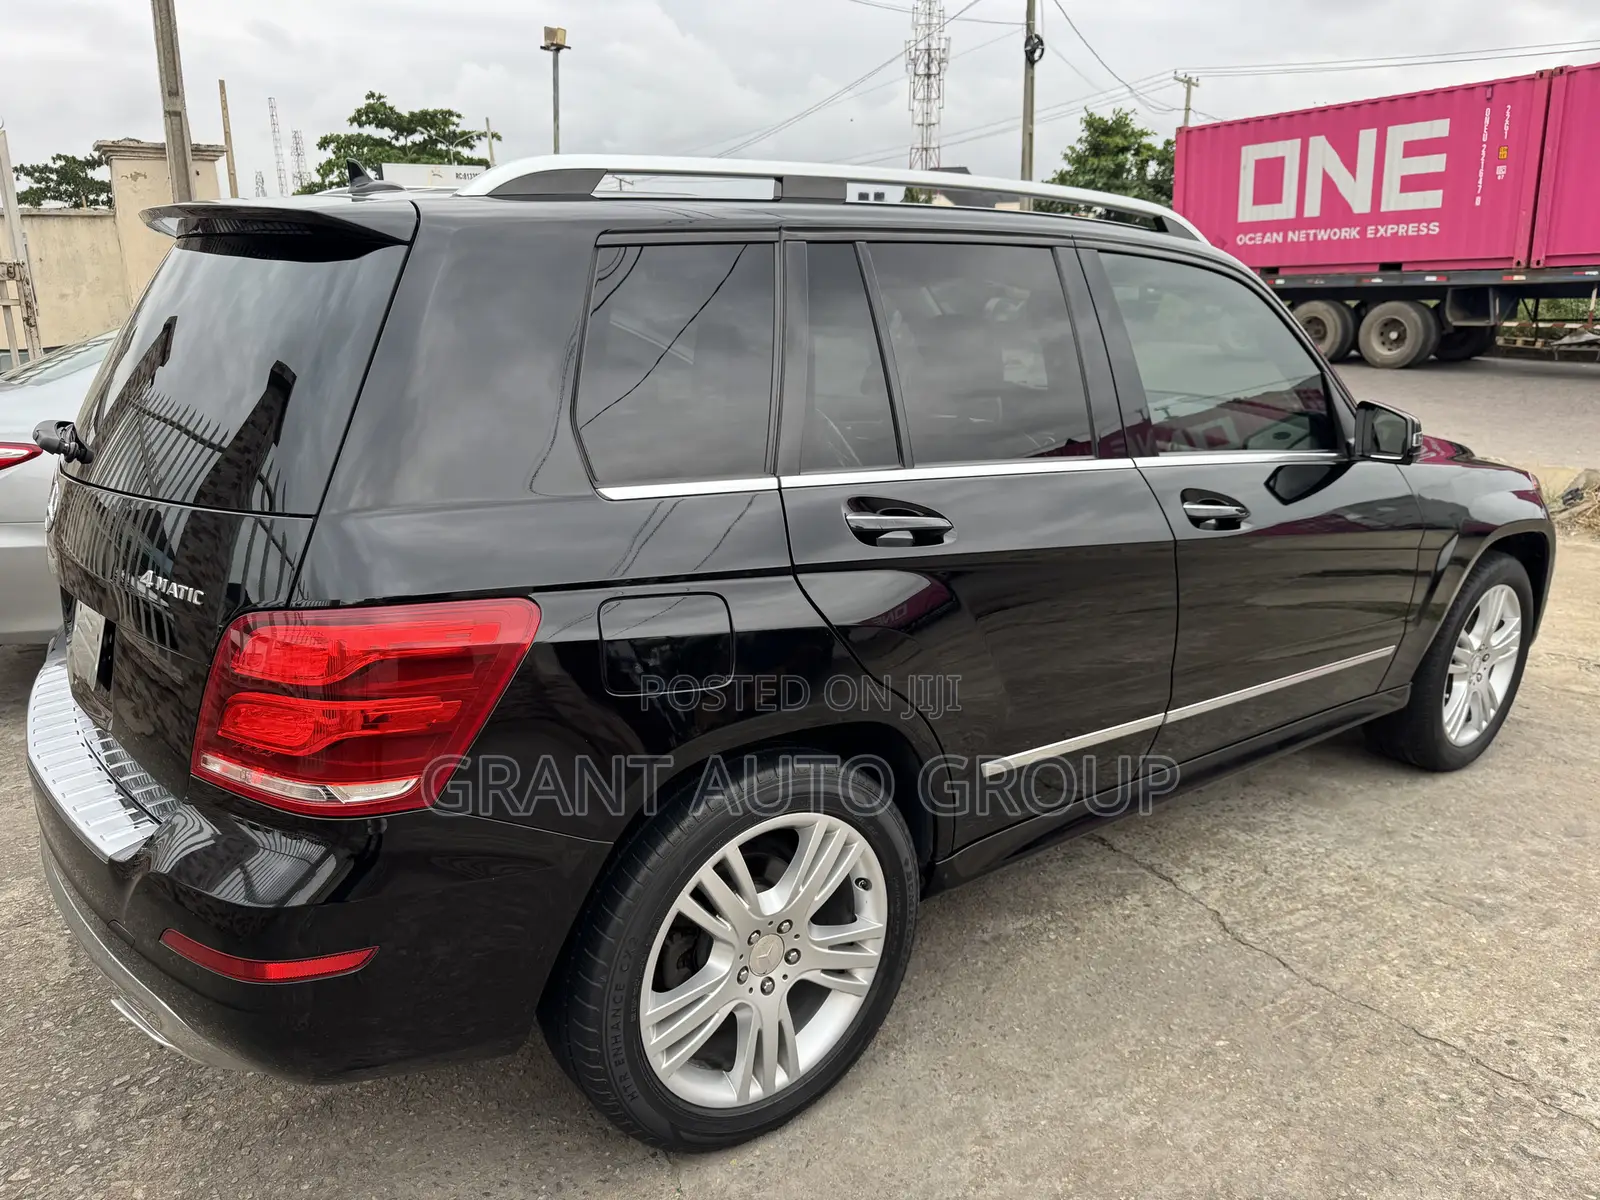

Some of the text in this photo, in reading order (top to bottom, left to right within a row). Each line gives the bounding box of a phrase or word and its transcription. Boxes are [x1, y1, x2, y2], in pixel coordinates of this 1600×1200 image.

[1482, 107, 1491, 142] ONEU
[1237, 118, 1450, 223] ONE
[1236, 221, 1440, 246] OCEAN NETWORK EXPRESS
[140, 569, 205, 606] 4MATIC
[610, 982, 626, 1067] ENHANCE
[619, 1071, 639, 1101] HTR
